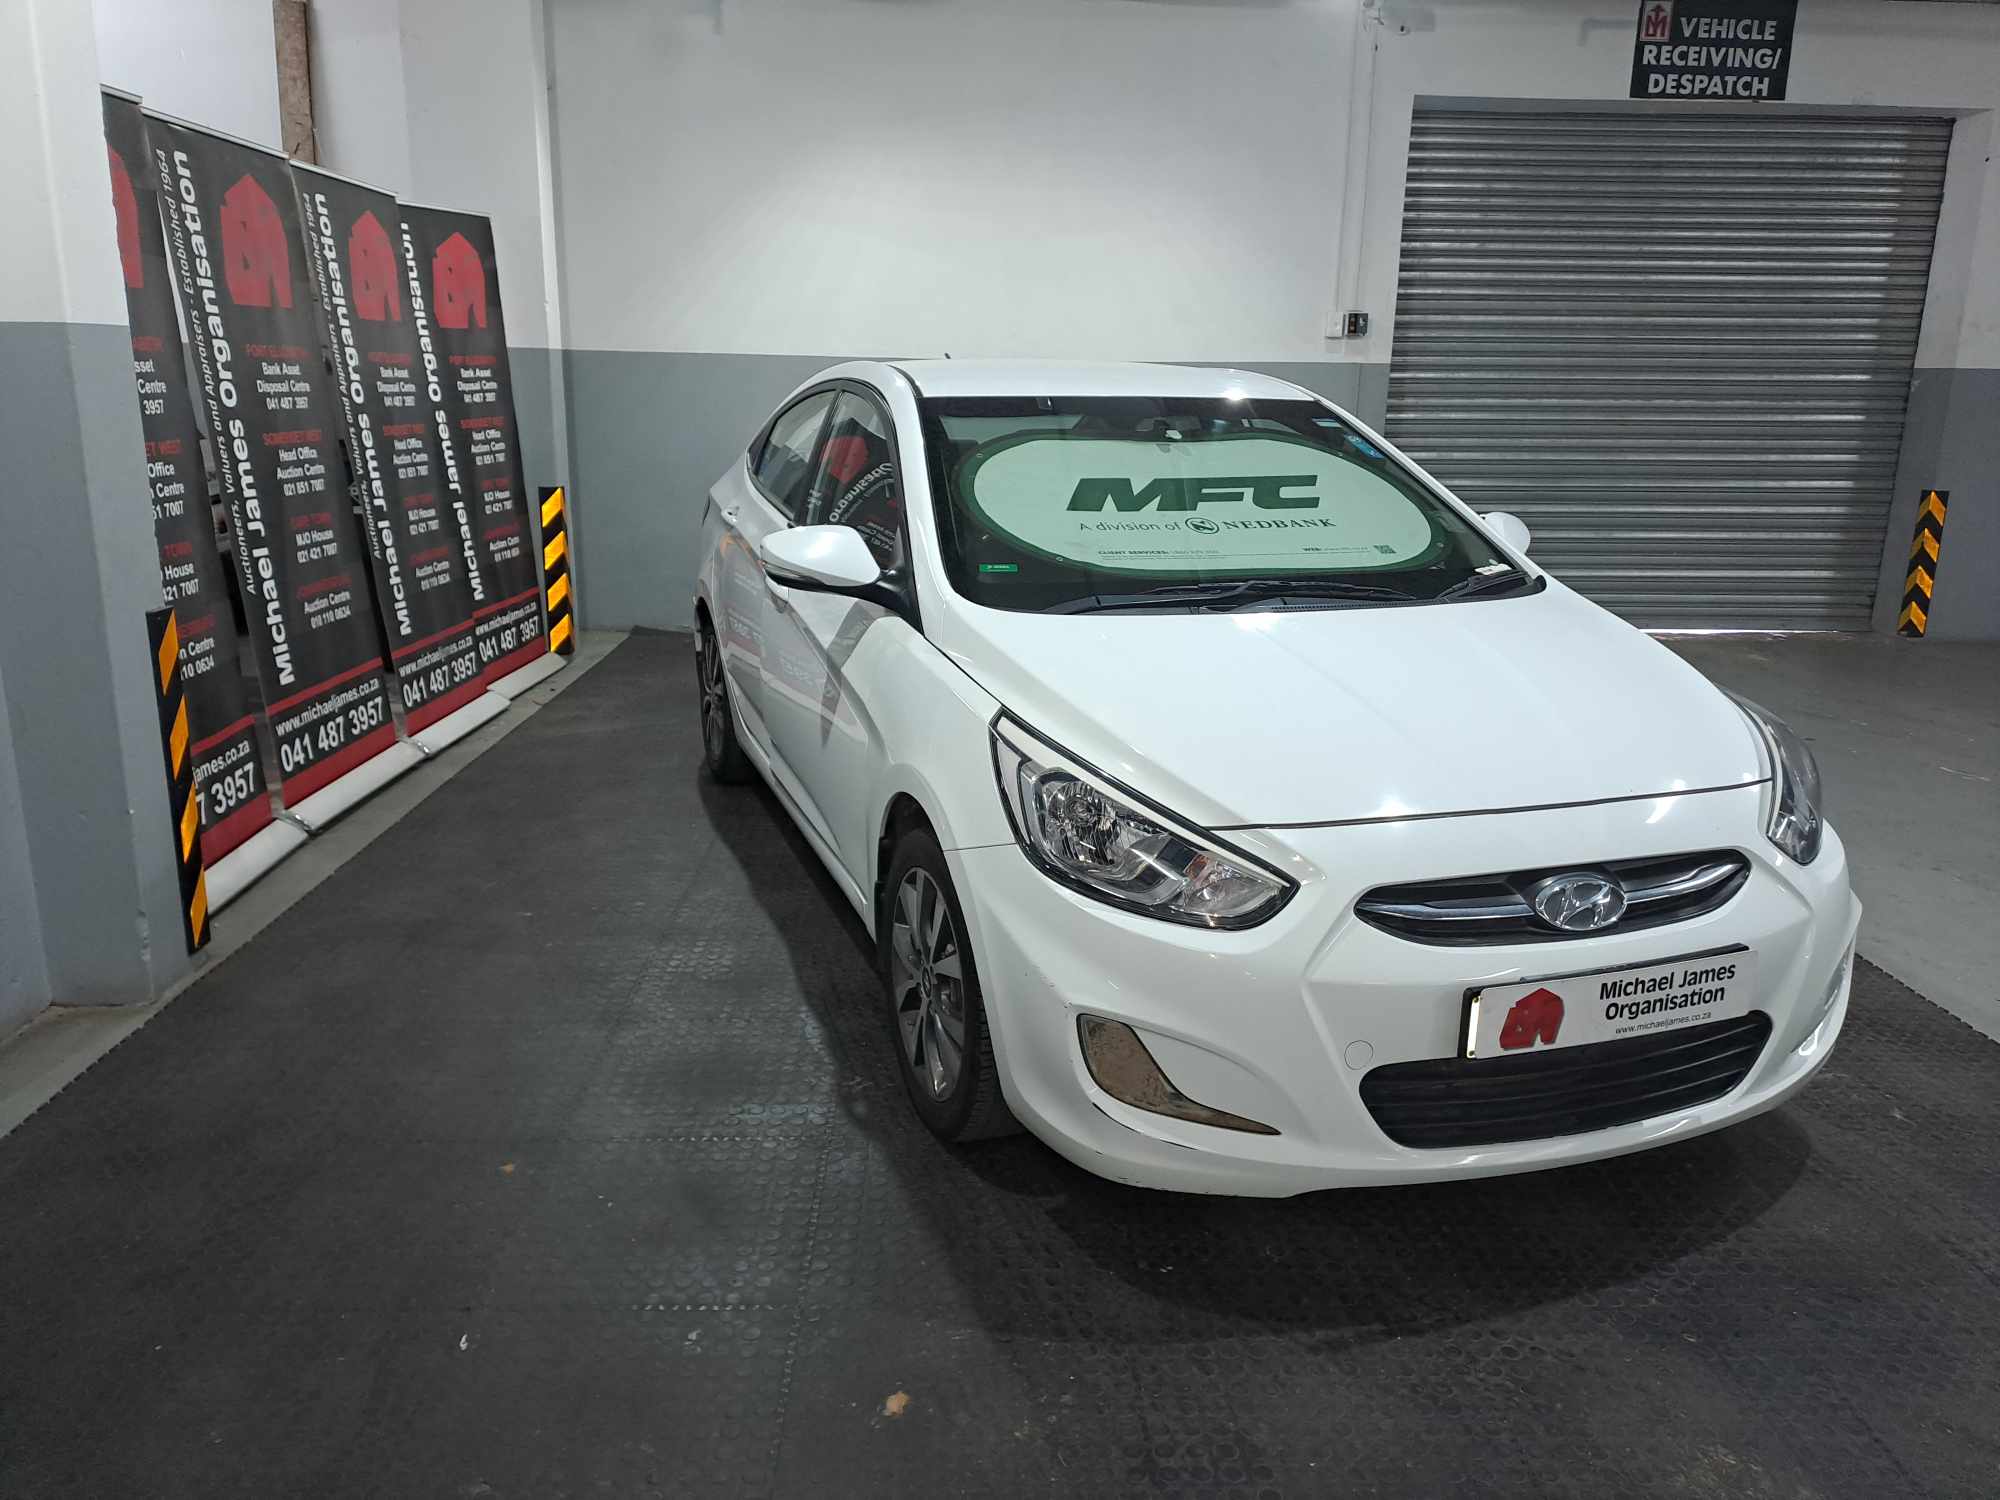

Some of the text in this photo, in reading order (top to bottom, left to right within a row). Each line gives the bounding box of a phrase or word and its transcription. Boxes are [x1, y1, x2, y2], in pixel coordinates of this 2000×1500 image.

[1680, 17, 1777, 40] VEHICLE
[1642, 45, 1782, 69] RECEIVING/
[1647, 73, 1770, 97] DESPATCH
[156, 148, 173, 192] 1964
[164, 196, 194, 294] Established
[190, 309, 215, 396] Appraisers
[261, 362, 281, 375] Bank
[137, 379, 167, 394] Centre
[143, 399, 164, 415] 3957
[174, 150, 295, 686] Michael James Organisation
[207, 398, 223, 431] and
[315, 193, 412, 636] Michael James Organisation
[217, 435, 235, 494] Valuers
[435, 409, 462, 494] James
[148, 462, 175, 478] Office
[156, 482, 185, 498] Centre
[1066, 474, 1321, 512] MFC
[164, 500, 184, 517] 7007
[1080, 518, 1337, 531] A division of NEDBANK
[452, 501, 485, 601] Michael
[164, 563, 195, 580] House
[180, 579, 199, 597] 7007
[188, 638, 215, 657] Centre
[478, 615, 539, 662] 041 487 3957
[195, 655, 215, 674] 0634
[402, 651, 477, 707] 041 487 3957
[275, 678, 380, 737] www.michaeljames.co.za
[280, 696, 383, 772] 041 487 3957
[211, 762, 254, 814] 3957
[1600, 964, 1737, 1001] Michael James
[1605, 987, 1725, 1020] Organisation
